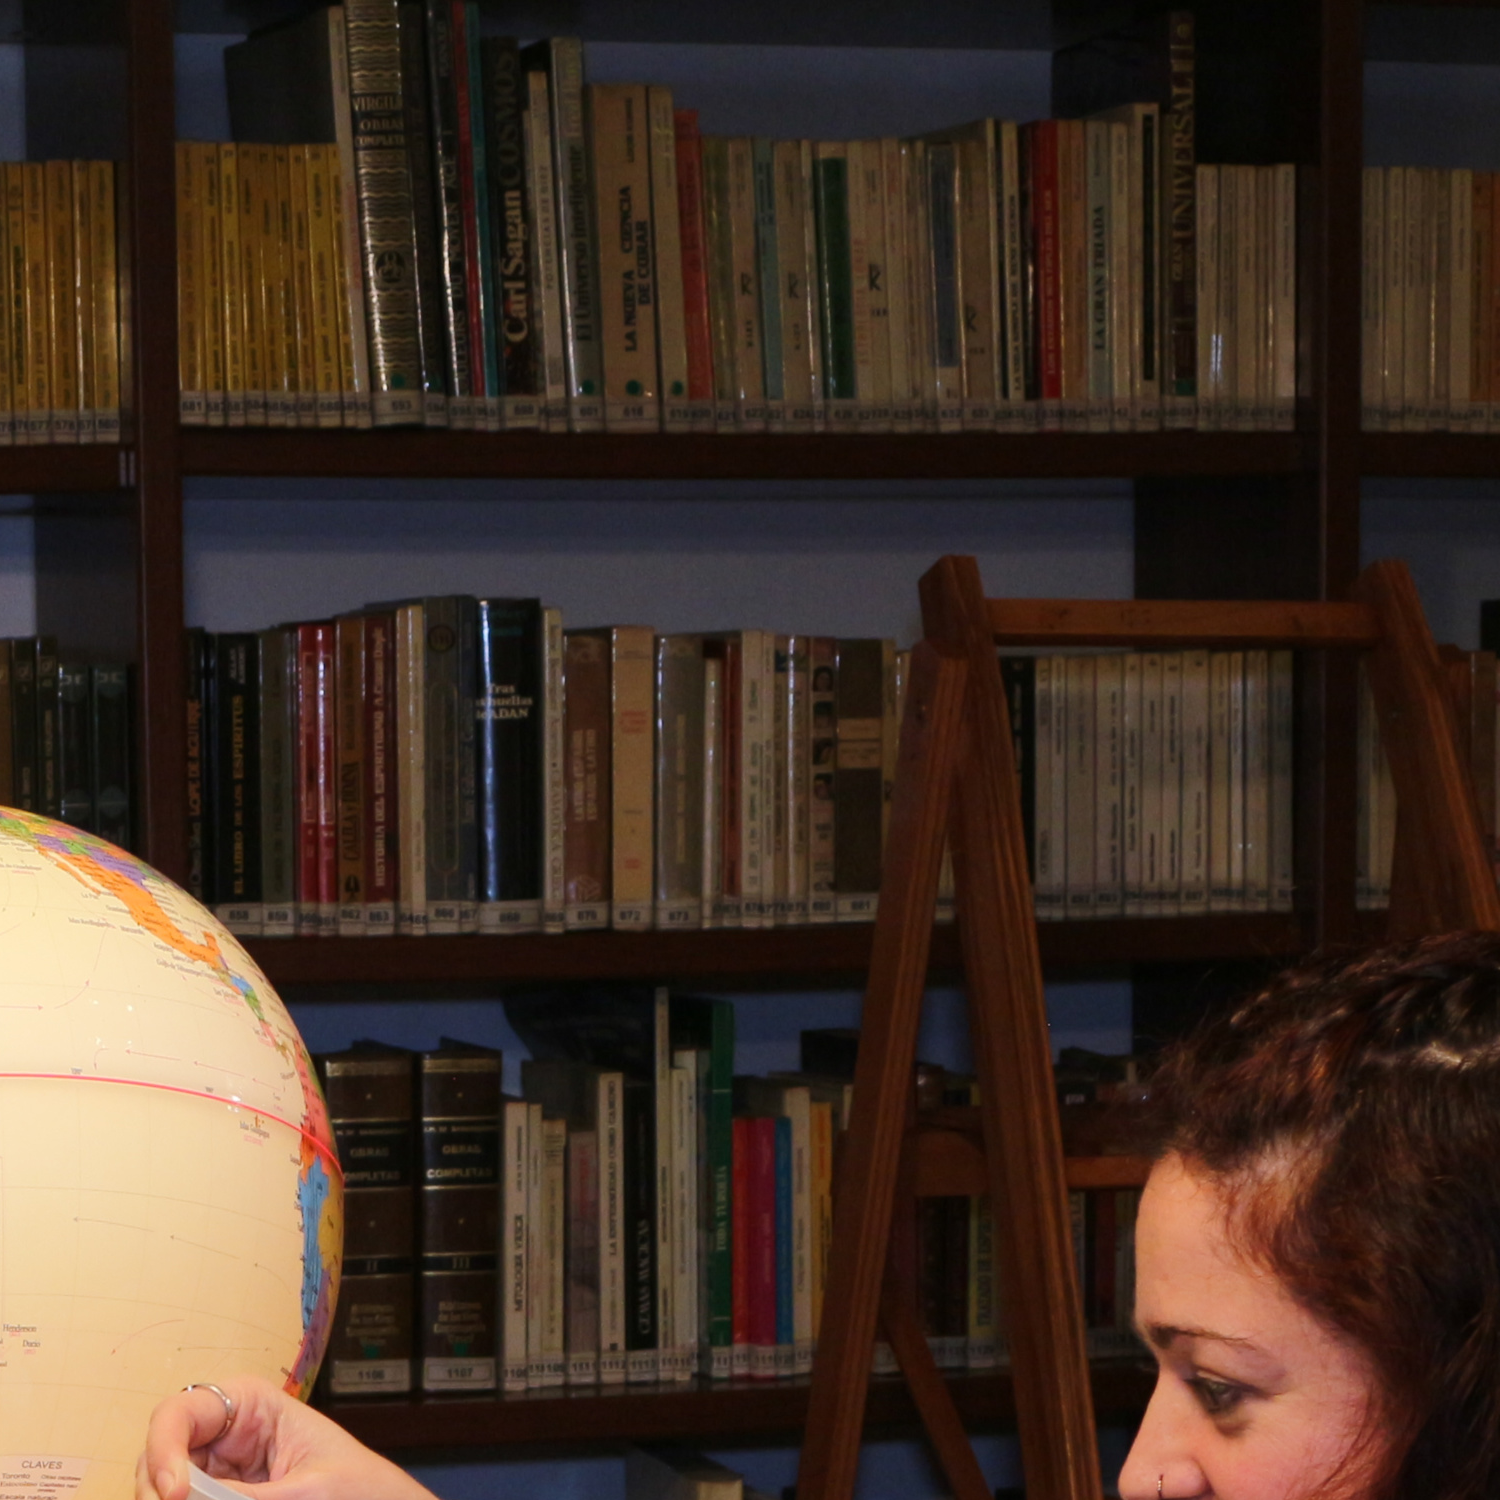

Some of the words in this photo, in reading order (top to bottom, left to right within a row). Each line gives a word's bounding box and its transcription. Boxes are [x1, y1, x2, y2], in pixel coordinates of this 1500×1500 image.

[494, 51, 520, 186] COSMOS
[1171, 77, 1195, 239] UNIVERSAL
[567, 145, 589, 237] inteligente
[499, 188, 527, 277] Sagan
[619, 185, 634, 254] CIENCIA
[636, 219, 650, 278] CURAR
[1092, 205, 1105, 269] TRIADA
[572, 240, 590, 320] Universo
[638, 283, 651, 305] DE
[500, 280, 528, 342] Carl
[622, 270, 636, 327] NUEVA
[1093, 274, 1106, 323] GRAN
[575, 323, 591, 341] El
[624, 330, 637, 352] LA
[1094, 327, 1106, 351] LA
[231, 694, 245, 780] ESPIRITUS
[373, 710, 385, 794] ESPIRITISMO
[187, 759, 200, 778] DE
[187, 780, 202, 817] LOPE
[233, 783, 243, 807] LOS
[374, 797, 385, 822] DEL
[234, 810, 244, 827] DE
[233, 830, 244, 874] LIBRO
[374, 825, 386, 887] HISTORIA
[233, 877, 245, 895] EL
[619, 910, 640, 920] 872
[441, 1144, 482, 1156] OBRAS
[425, 1167, 495, 1180] COMPLETAS
[715, 1220, 727, 1252] TODA
[451, 1256, 471, 1270] III
[447, 1368, 473, 1378] 1107
[21, 1460, 63, 1470] CLAVES
